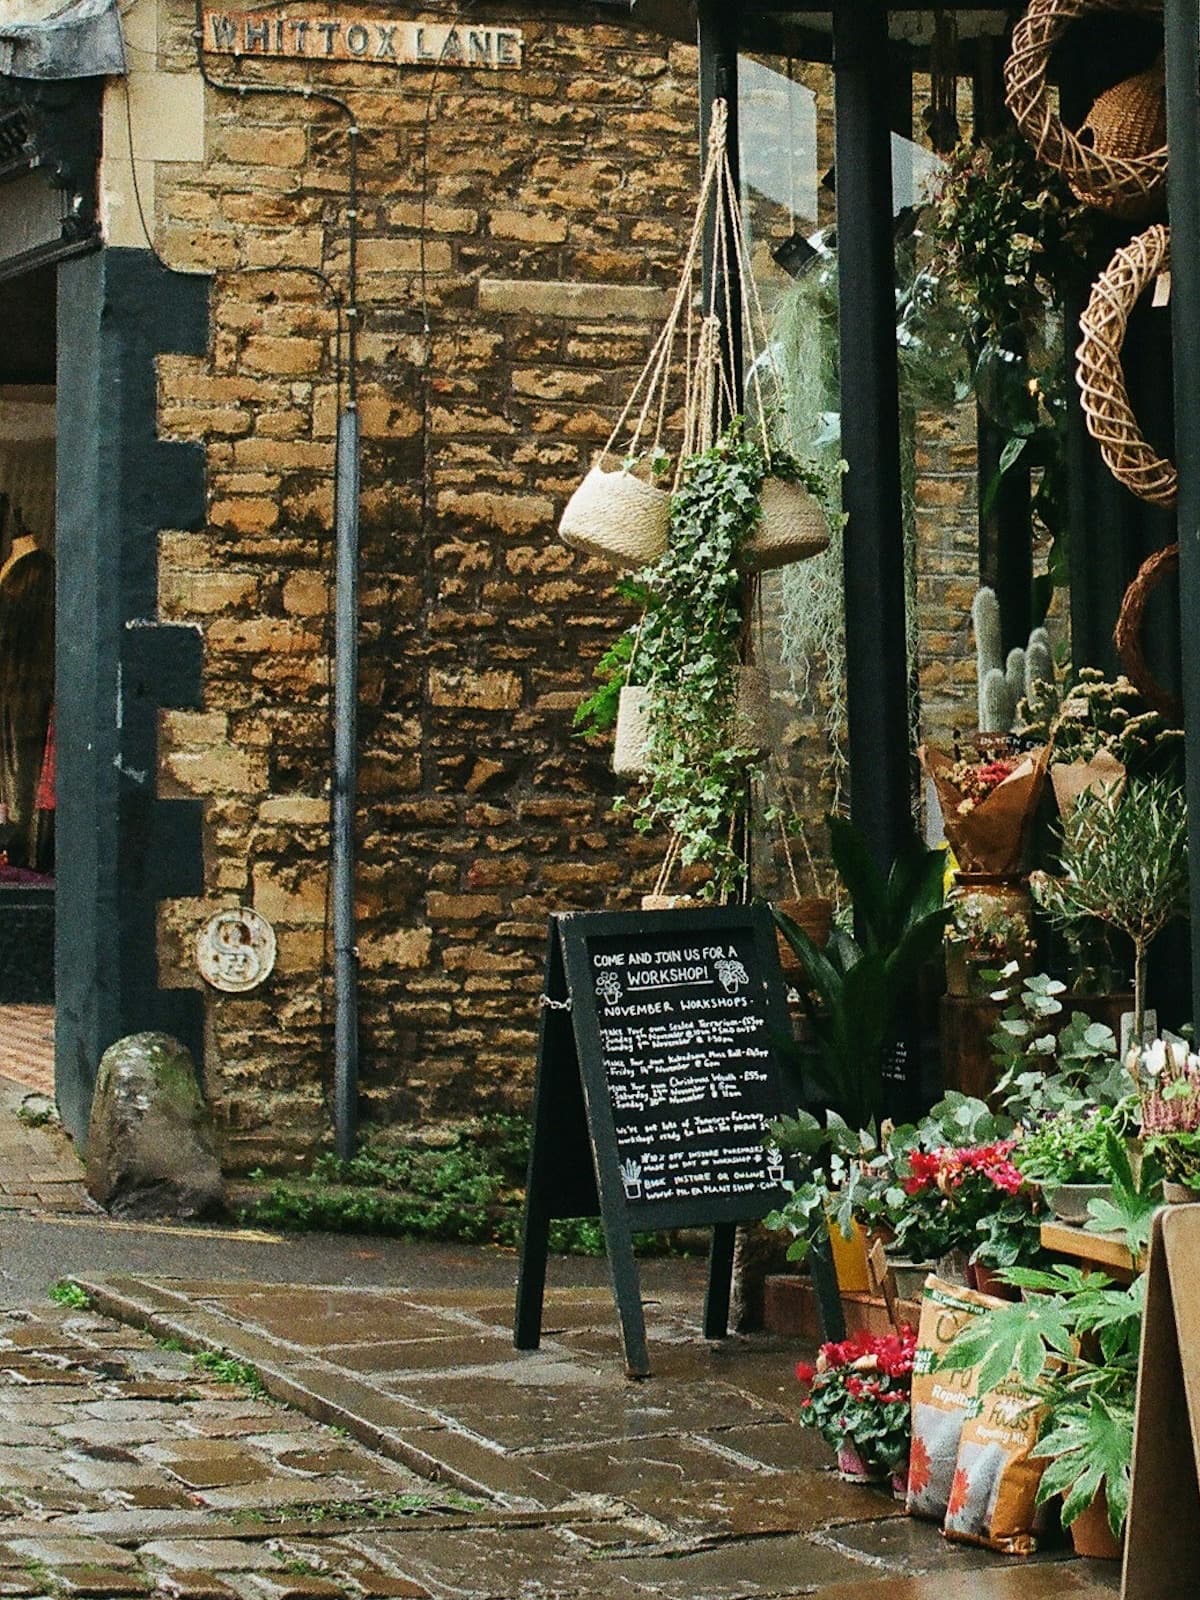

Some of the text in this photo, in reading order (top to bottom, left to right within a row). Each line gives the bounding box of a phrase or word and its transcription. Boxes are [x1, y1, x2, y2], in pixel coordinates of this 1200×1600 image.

[210, 14, 519, 65] WHITTOX LANE
[593, 945, 738, 967] COME AND JOIN US FOR A
[627, 966, 709, 986] WORKSHOP!
[604, 996, 748, 1017] NOVEMBER WORKSHOPS
[669, 1076, 710, 1088] Christmas
[681, 1118, 690, 1128] of
[684, 1129, 694, 1137] to
[668, 1151, 684, 1161] OFF
[674, 1172, 712, 1185] INSTORE
[717, 1172, 730, 1181] OR
[733, 1169, 765, 1180] ONLINE
